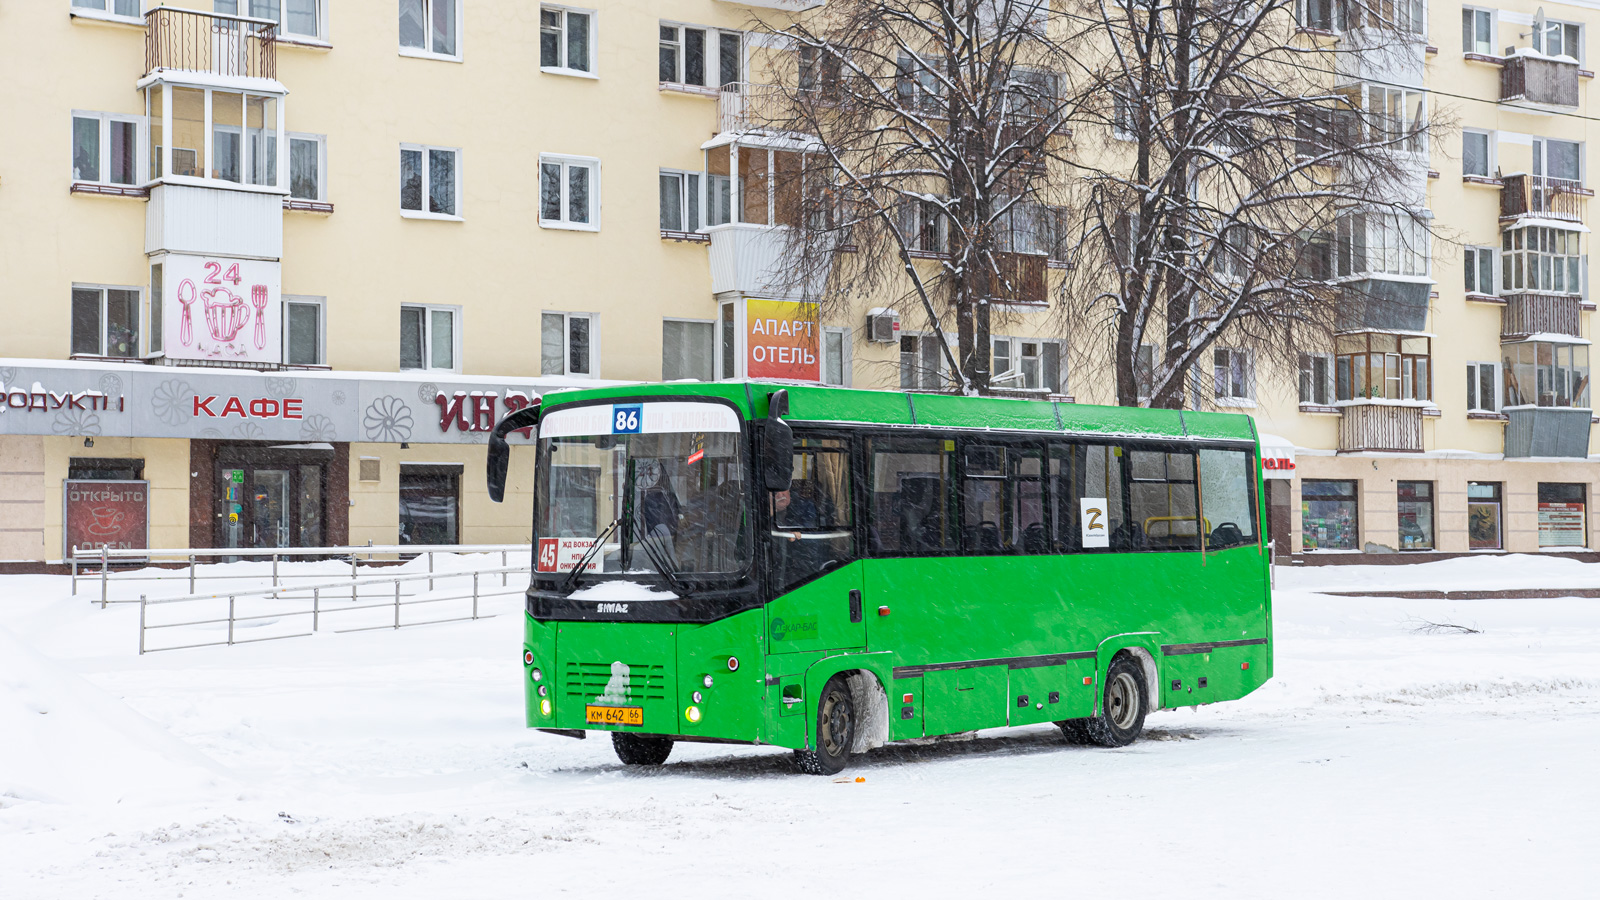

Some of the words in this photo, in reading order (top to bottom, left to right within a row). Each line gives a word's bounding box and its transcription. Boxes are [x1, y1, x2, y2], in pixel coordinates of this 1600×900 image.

[204, 261, 242, 285] 24
[752, 318, 815, 337] АПАРТ
[752, 345, 816, 364] ОТЕЛЬ
[192, 394, 303, 419] КАФЕ
[615, 411, 638, 430] 86
[69, 491, 143, 502] ОТКРЫТО
[1085, 507, 1104, 531] Z
[562, 541, 572, 549] ЖД
[540, 543, 556, 567] 45
[606, 709, 624, 721] 642
[629, 709, 639, 719] 66
